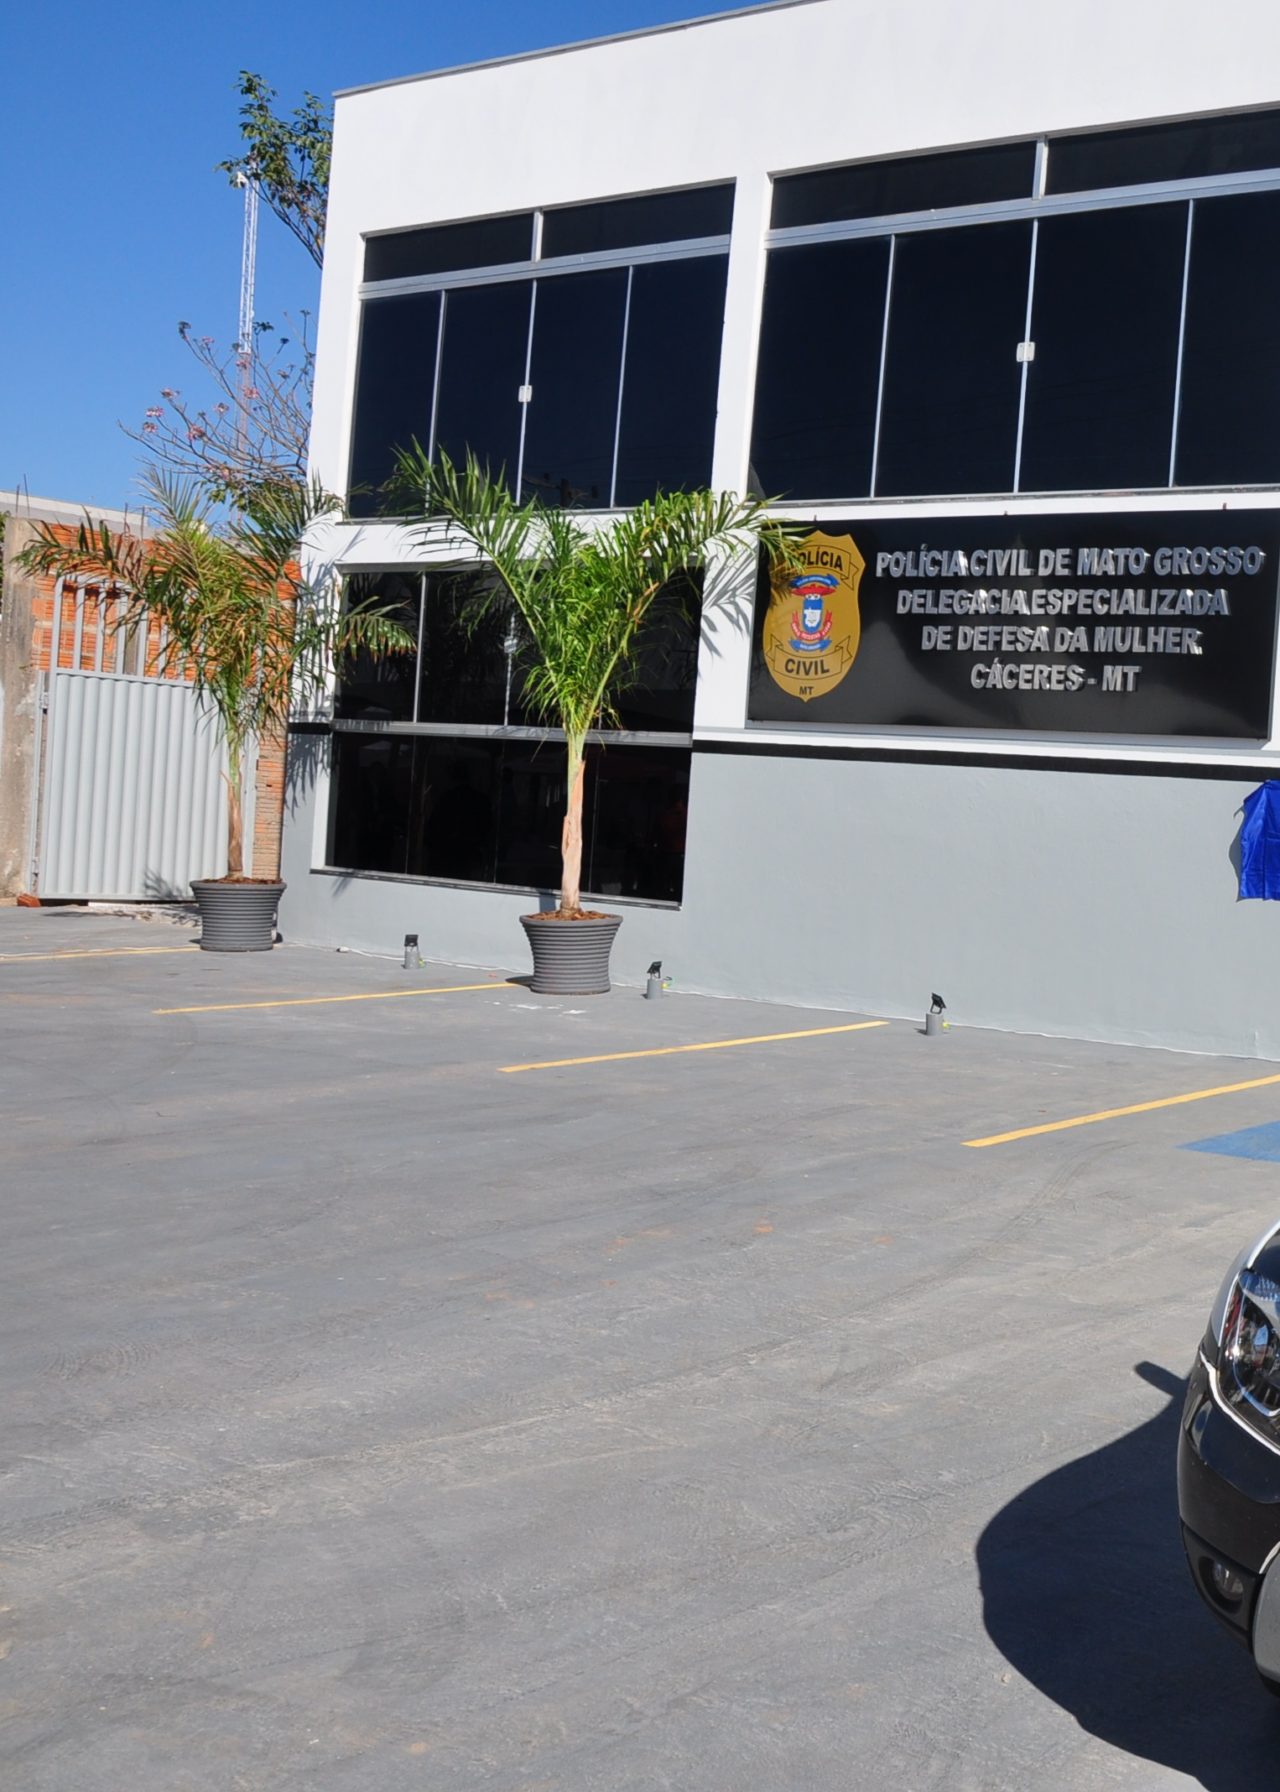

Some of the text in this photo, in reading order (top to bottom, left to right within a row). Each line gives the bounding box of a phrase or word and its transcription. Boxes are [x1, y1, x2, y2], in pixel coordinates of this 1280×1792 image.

[791, 547, 843, 571] OLÍCIA
[876, 544, 1265, 577] POLÍCIA CIVIL DE MATO GROSSO
[897, 588, 1231, 616] DELEGACIA ESPECIALIZADA
[921, 624, 1203, 655] DE DEFESA DA MULHER
[784, 657, 830, 676] CIVIL
[970, 657, 1086, 691] CÁCERES
[1101, 664, 1143, 692] MT
[799, 685, 815, 696] MT
